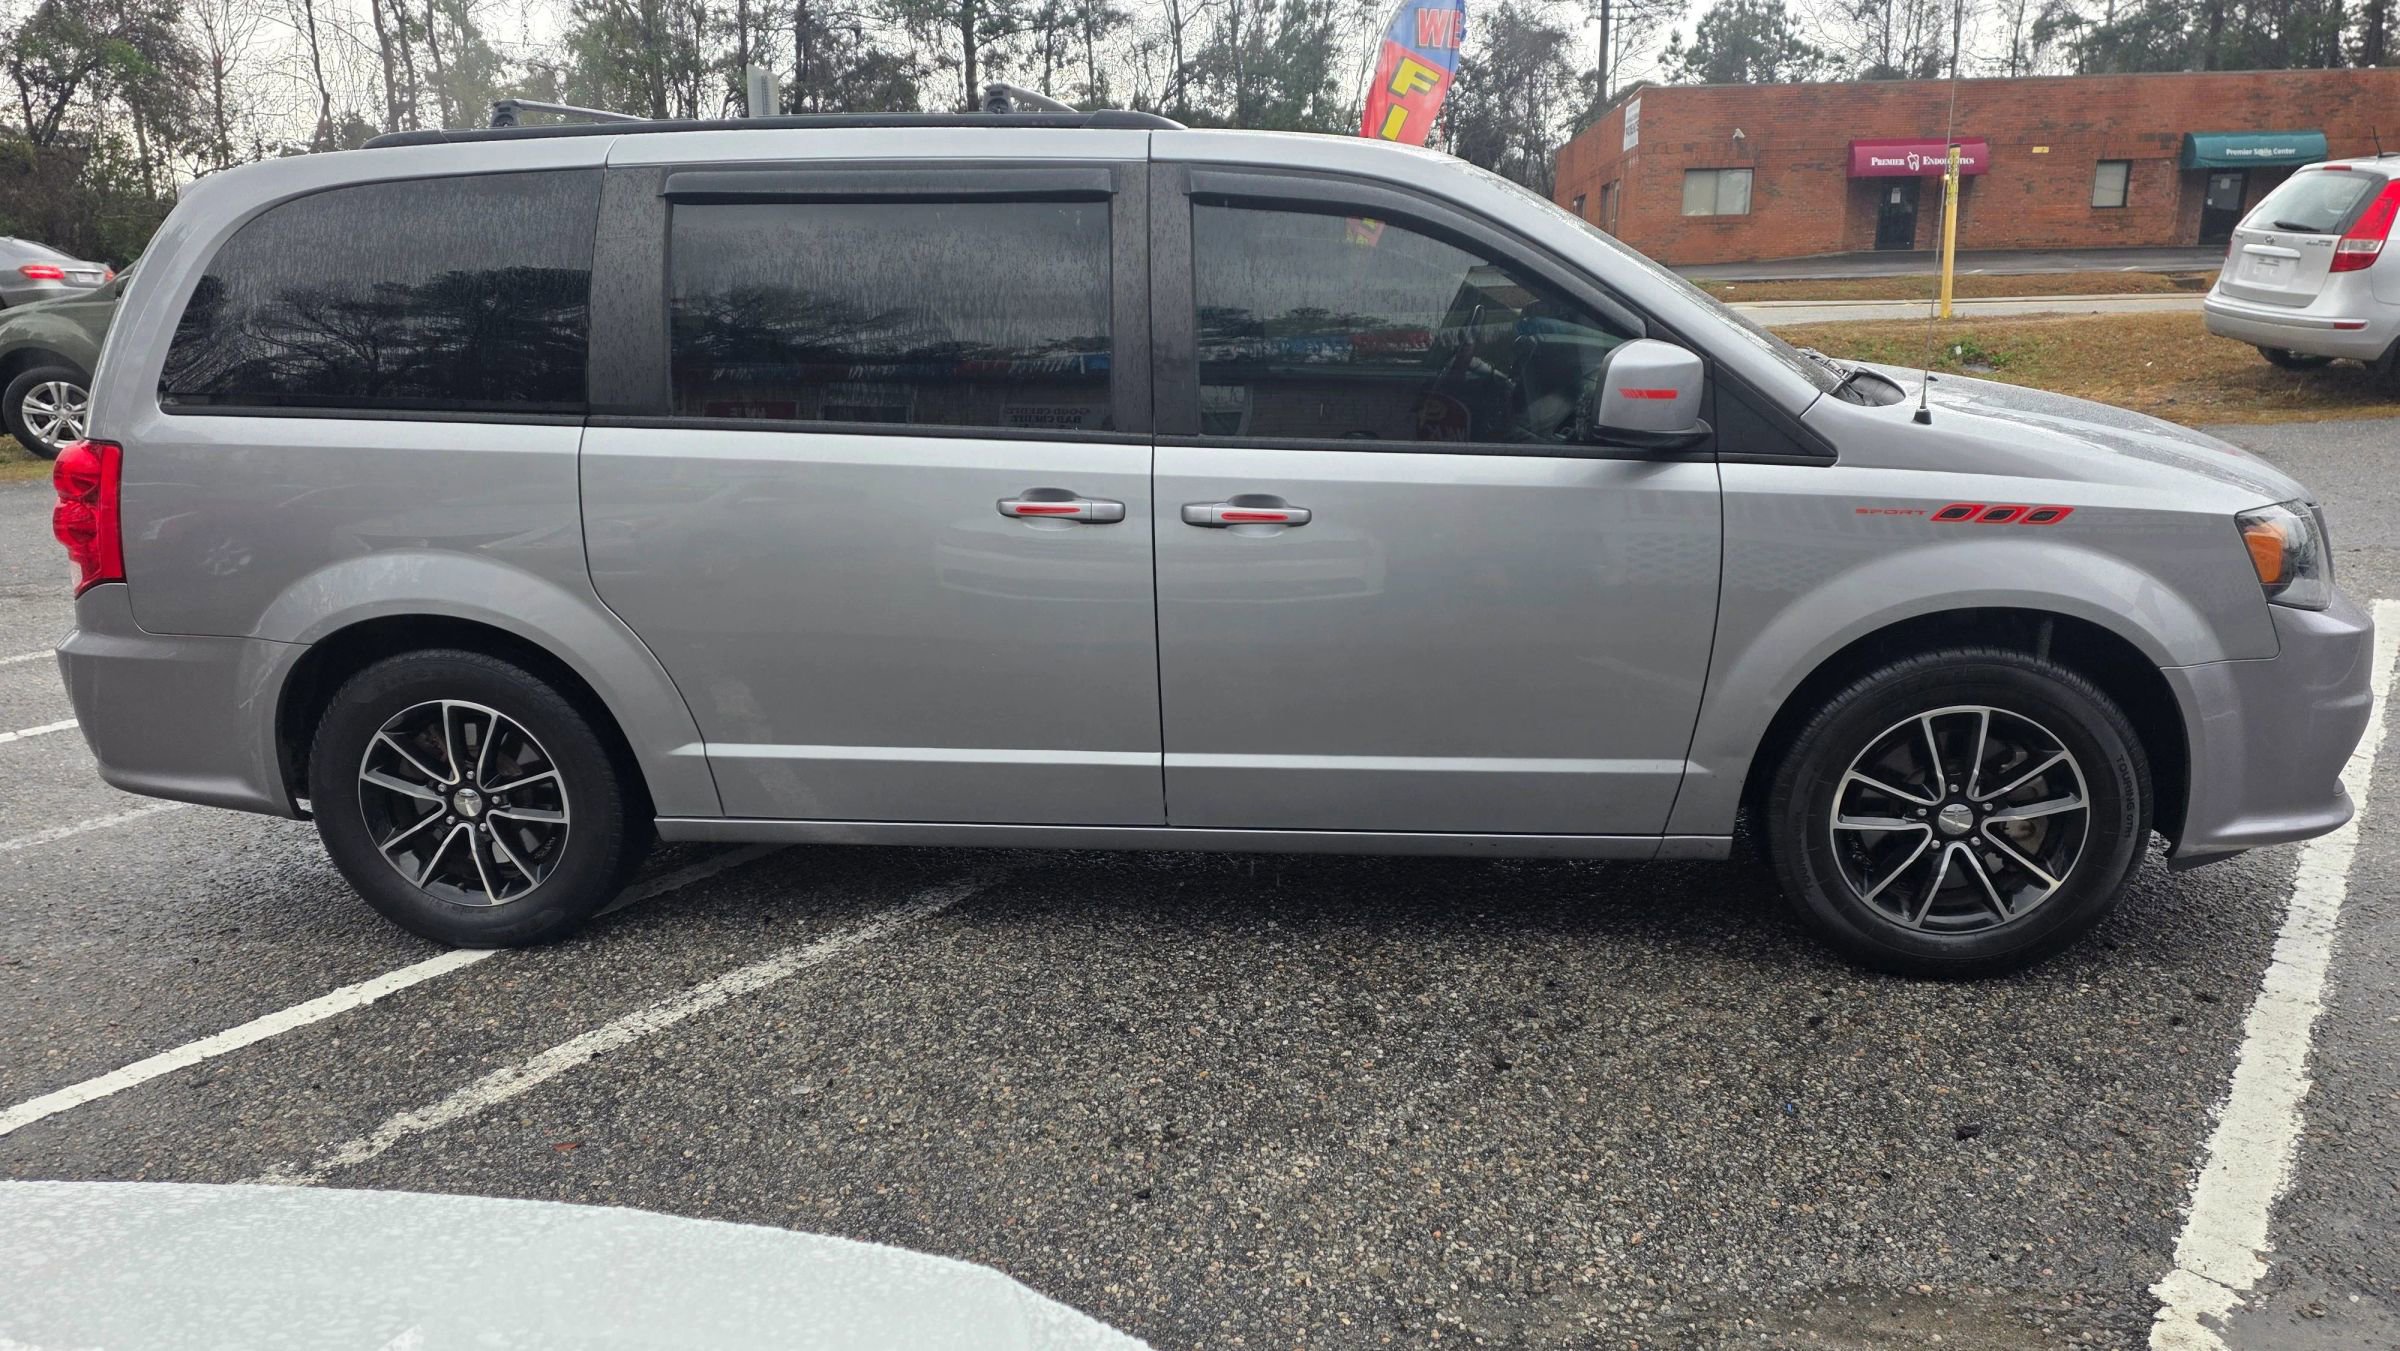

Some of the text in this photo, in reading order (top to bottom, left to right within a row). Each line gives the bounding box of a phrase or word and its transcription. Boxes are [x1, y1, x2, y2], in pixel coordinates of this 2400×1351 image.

[1417, 8, 1462, 49] WE
[2226, 148, 2253, 156] Premier
[2273, 147, 2296, 155] Center
[1871, 157, 1905, 166] PREMIER
[1855, 507, 1929, 516] SPORT
[2116, 754, 2136, 812] TOURING
